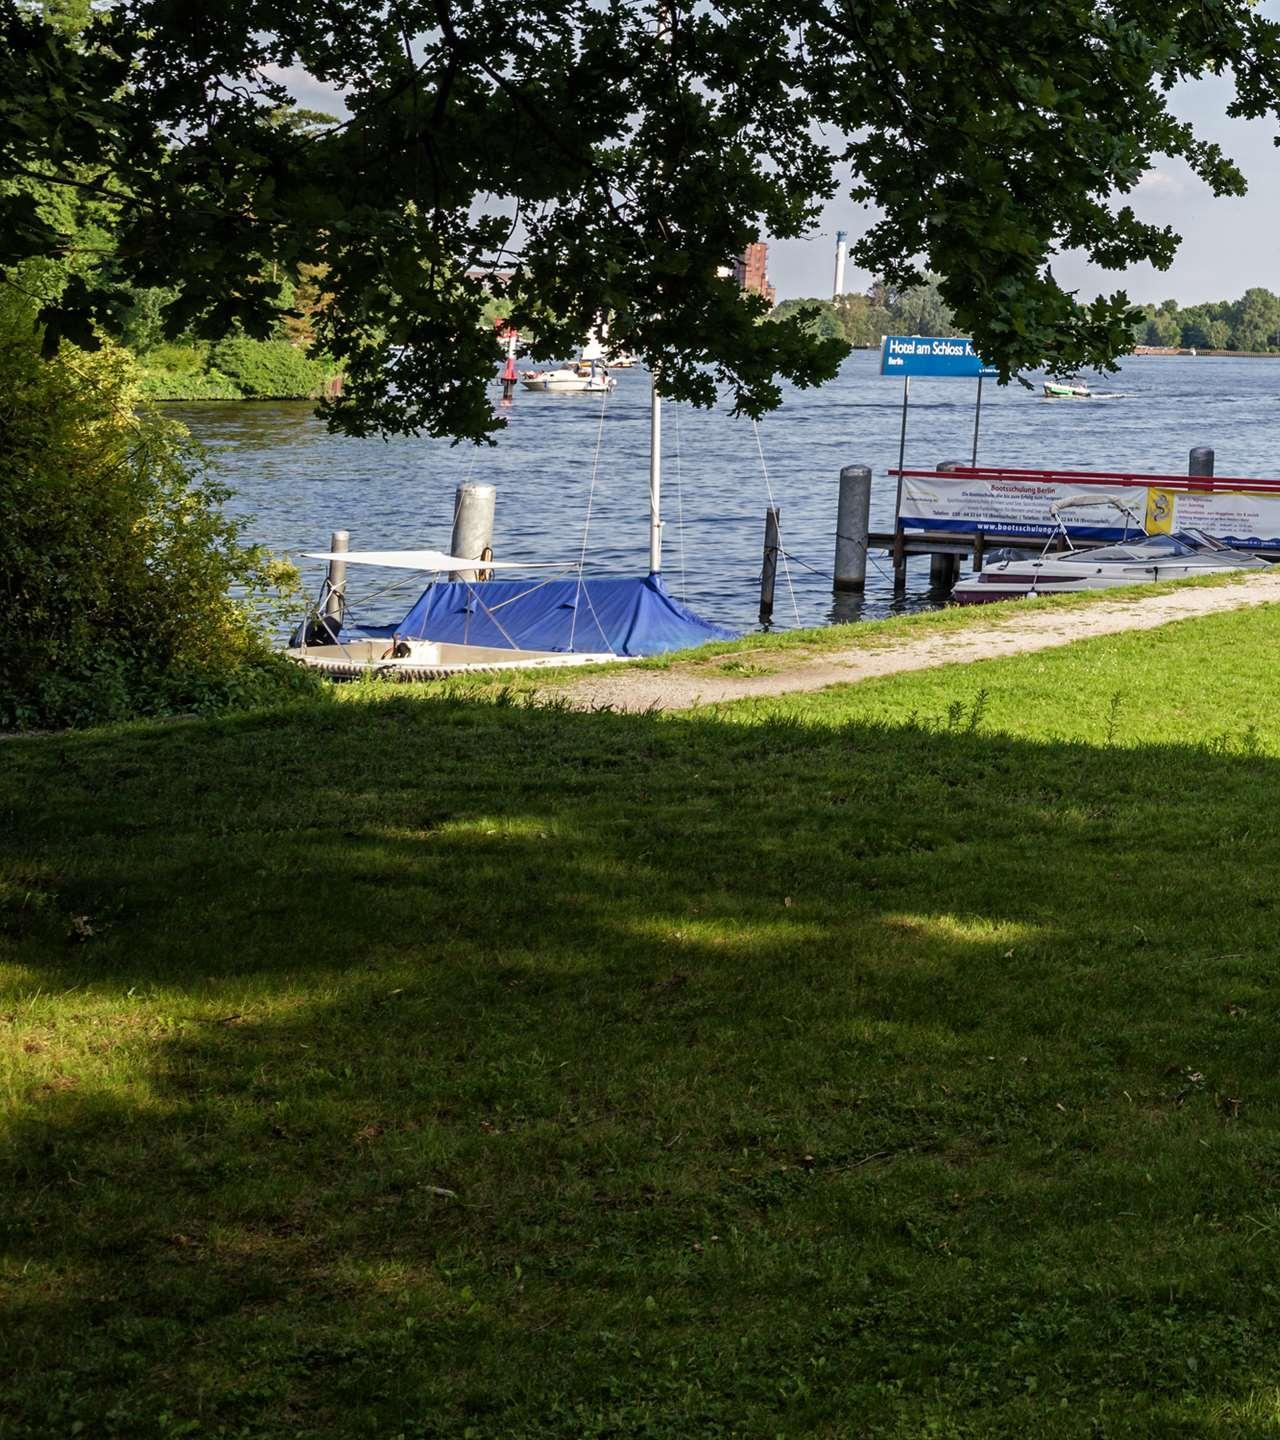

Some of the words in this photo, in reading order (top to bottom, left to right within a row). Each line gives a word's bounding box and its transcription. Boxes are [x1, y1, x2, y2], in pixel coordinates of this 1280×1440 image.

[889, 340, 915, 354] Hotel
[916, 344, 931, 355] am
[932, 341, 964, 356] Schloss
[888, 357, 903, 365] Berlin
[991, 484, 1036, 494] Bootsschulung
[1036, 486, 1056, 495] Berlin
